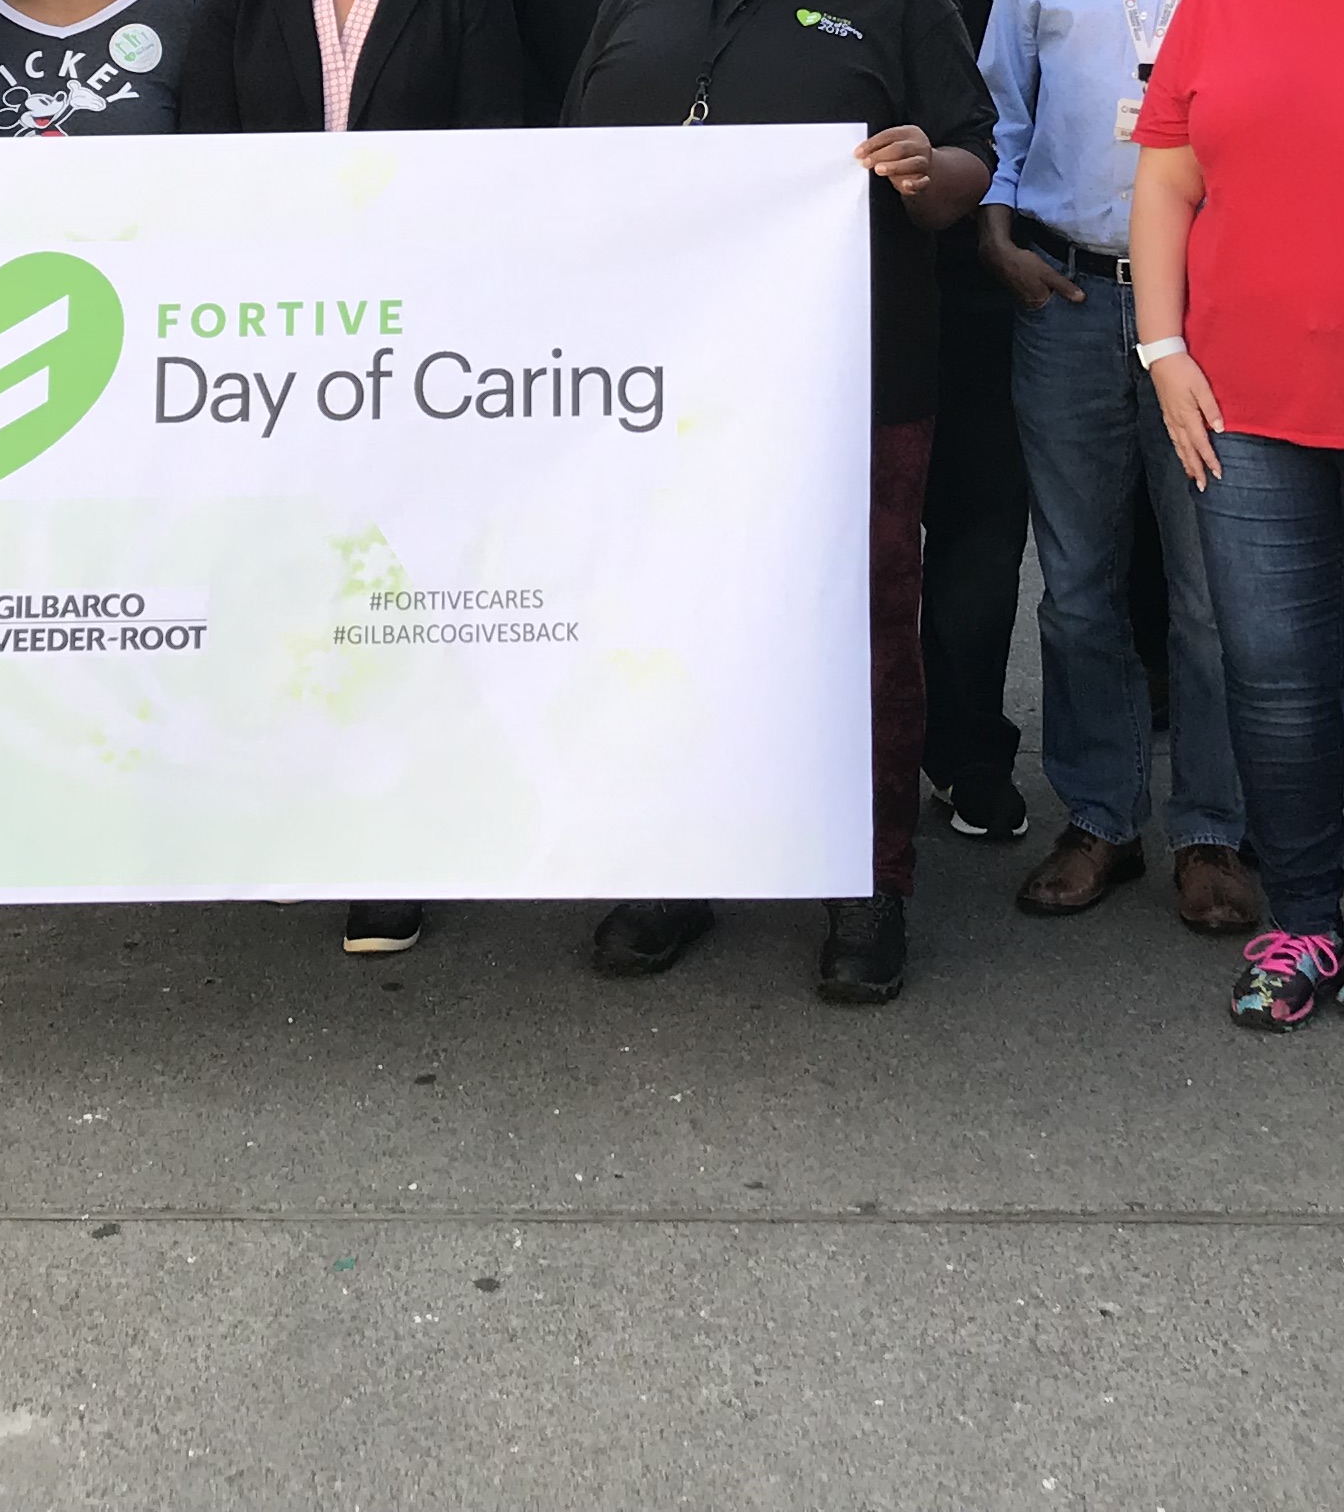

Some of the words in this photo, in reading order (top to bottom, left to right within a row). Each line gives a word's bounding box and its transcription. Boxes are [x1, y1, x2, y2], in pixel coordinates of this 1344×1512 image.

[817, 21, 848, 37] 2019
[157, 299, 404, 339] FORTIVE
[156, 356, 297, 438] Day
[317, 348, 394, 422] of
[414, 348, 664, 433] Caring
[369, 590, 544, 611] #FORTIVECARES
[333, 622, 580, 646] #GILBARCOGIVESBACK
